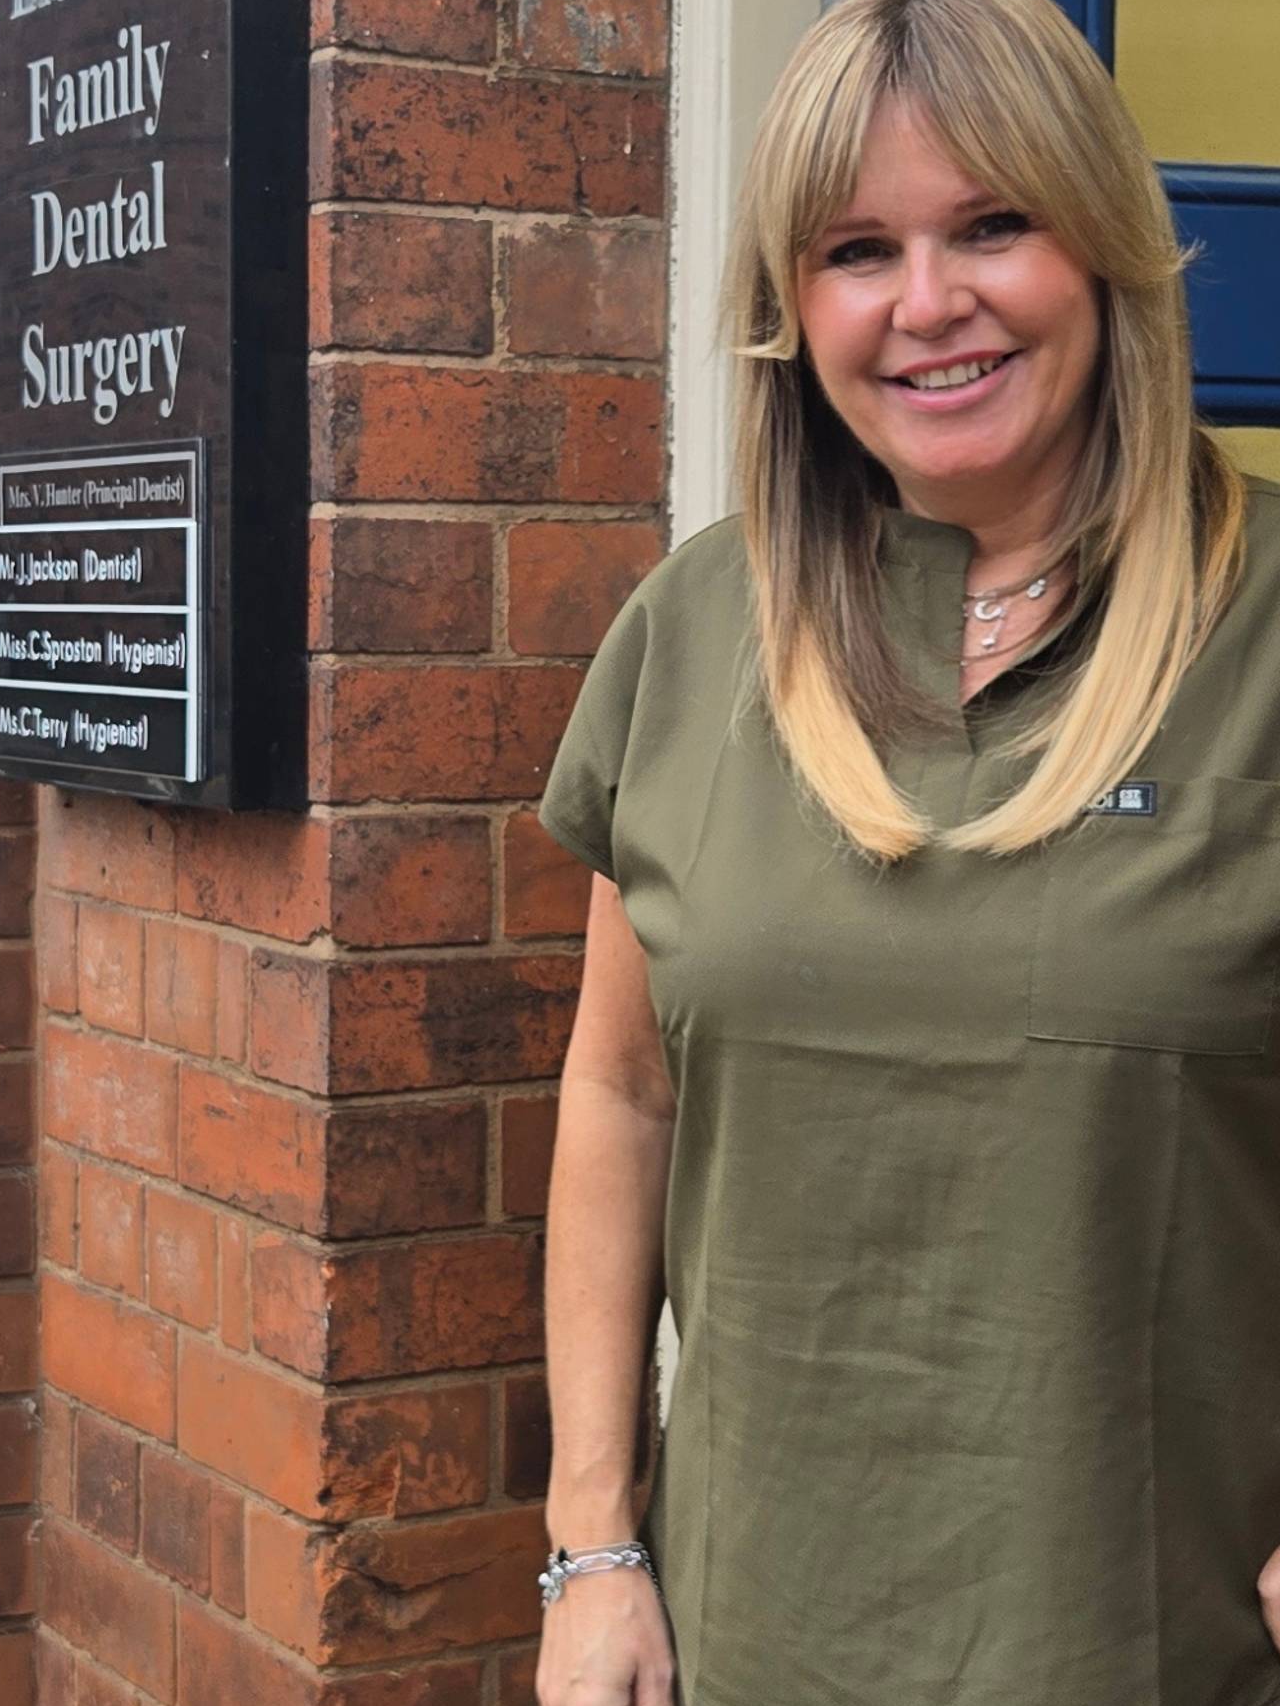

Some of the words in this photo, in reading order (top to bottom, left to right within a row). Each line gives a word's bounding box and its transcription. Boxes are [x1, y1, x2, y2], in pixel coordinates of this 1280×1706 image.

[27, 24, 171, 145] Family
[30, 160, 167, 276] Dental
[23, 322, 186, 425] Surgery
[45, 483, 82, 507] Hunter
[83, 478, 137, 509] (Principal
[138, 474, 185, 506] Dentist)
[83, 547, 142, 583] (Dentist)
[106, 630, 185, 673] (Hygienist)
[72, 709, 148, 753] (Hygienist)
